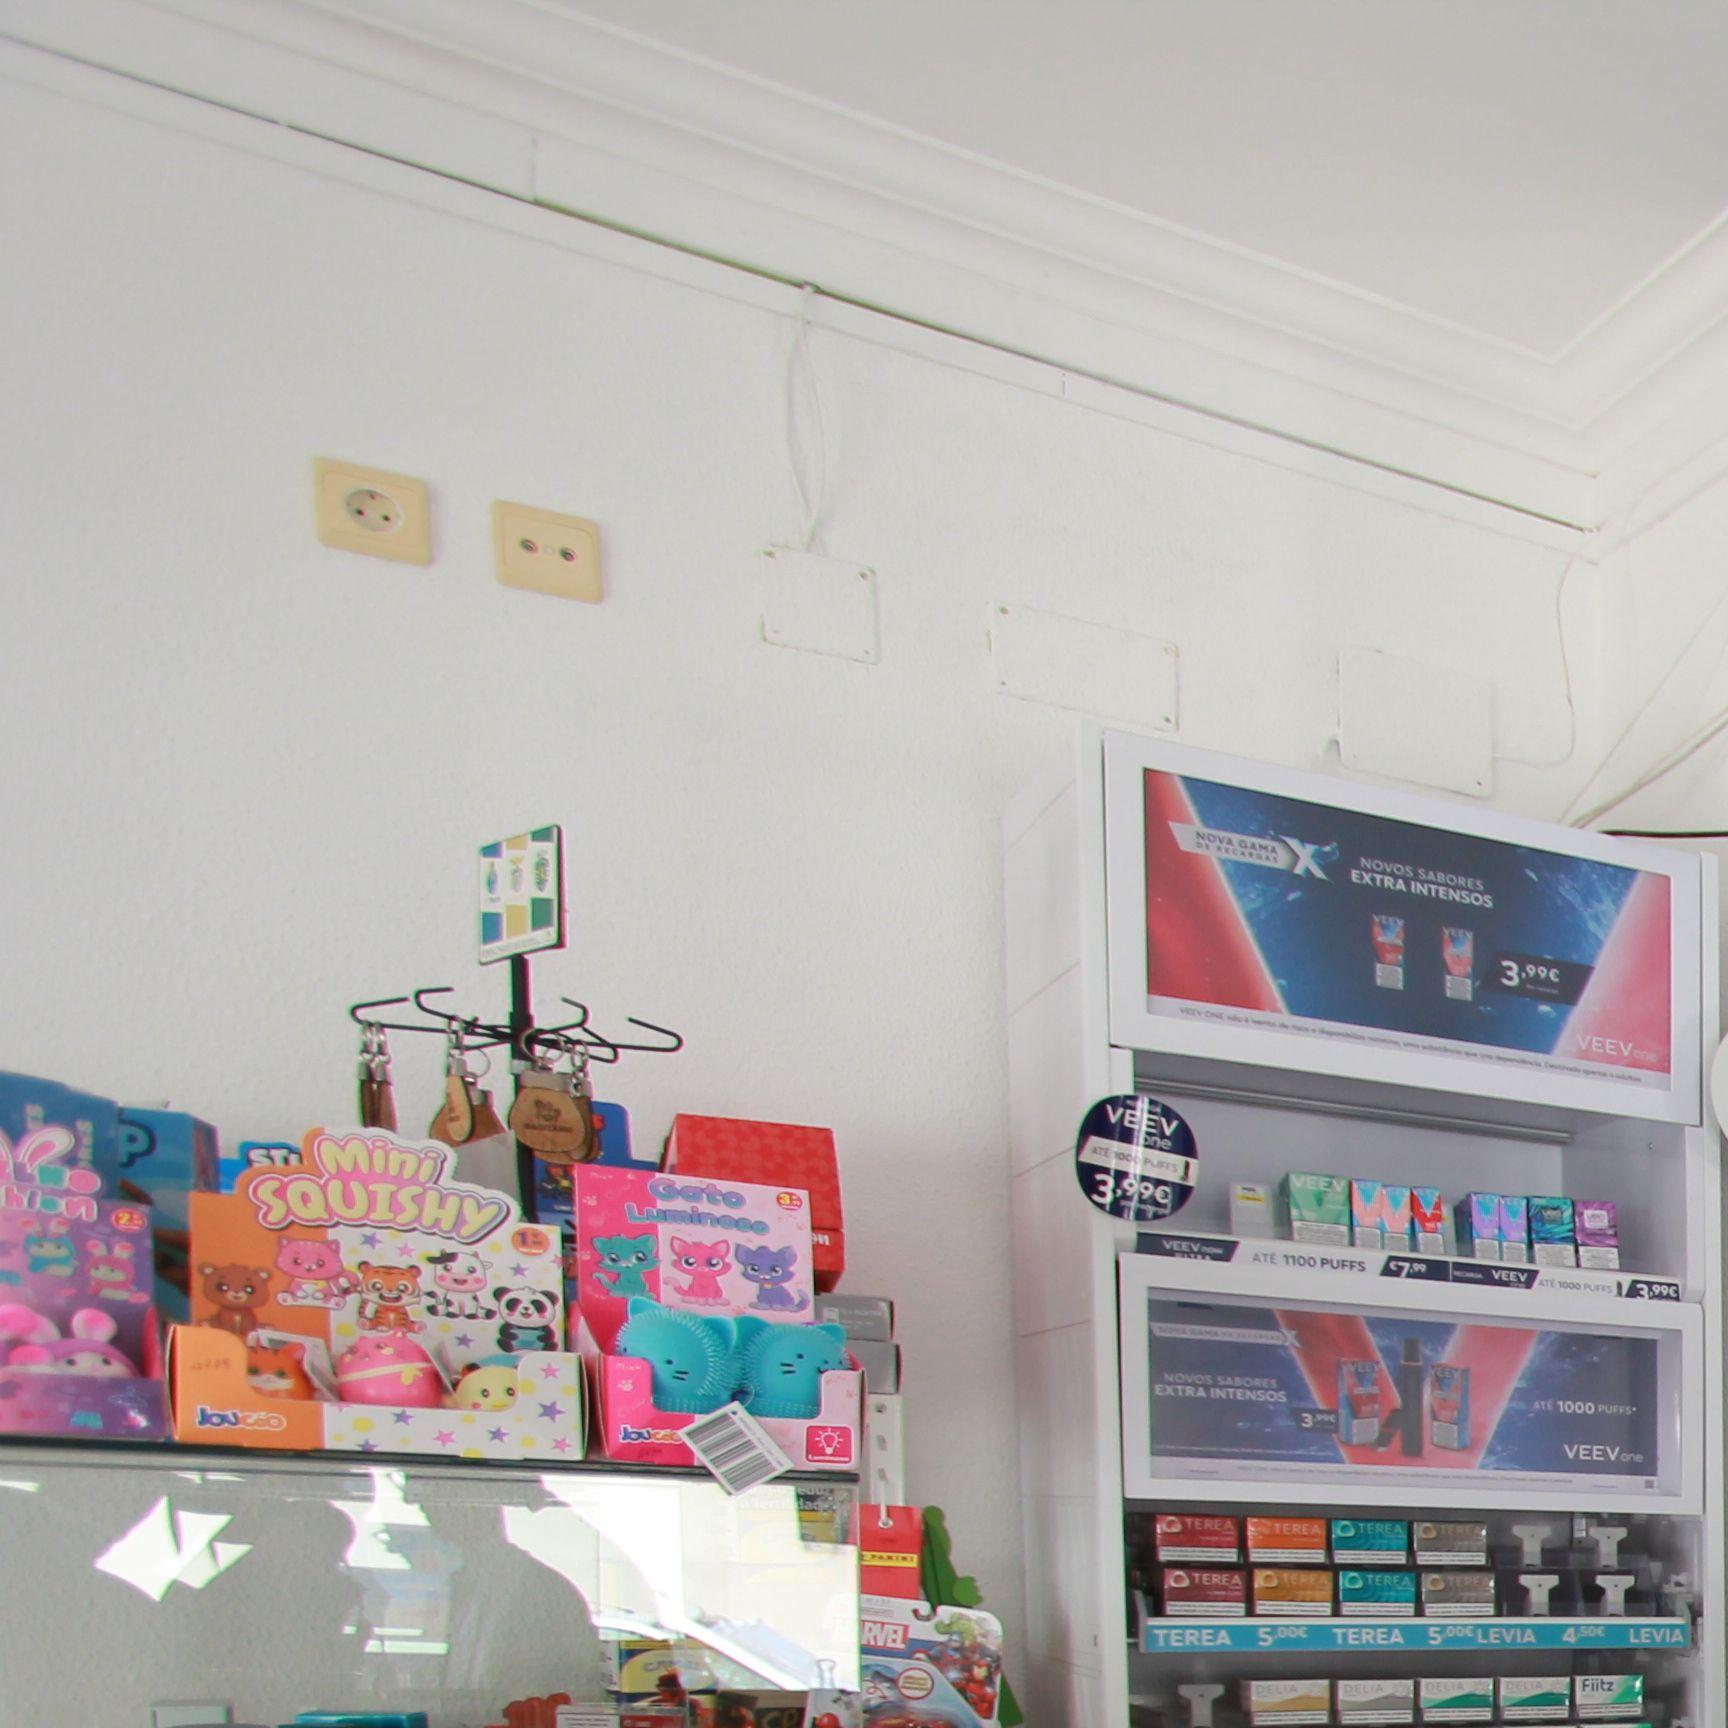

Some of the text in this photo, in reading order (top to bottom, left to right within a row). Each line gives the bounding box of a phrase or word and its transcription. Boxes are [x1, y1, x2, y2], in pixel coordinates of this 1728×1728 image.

[1195, 830, 1279, 857] NOVA GAMA
[1360, 856, 1484, 891] NOVOS SABORES
[1351, 870, 1493, 909] EXTRA INTENSOS
[1576, 1034, 1632, 1057] VEEV
[1106, 1103, 1179, 1136] VEEV
[320, 1138, 446, 1182] Mini
[1291, 1174, 1346, 1192] VEEV
[649, 1178, 747, 1210] Gato
[257, 1176, 506, 1239] SQUISHY
[626, 1203, 769, 1236] Luminoso
[1162, 1239, 1200, 1252] VEEV
[1252, 1251, 1366, 1272] ATÉ 1100 PUFFS
[1492, 1269, 1528, 1282] VEEV
[1163, 1372, 1277, 1389] NOVOS SABORES
[1154, 1384, 1287, 1403] EXTRA INTENSOS
[1533, 1399, 1553, 1412] ATÉ
[1557, 1400, 1595, 1415] 1000
[1563, 1443, 1644, 1463] VEEV one
[1185, 1517, 1237, 1531] TEREA
[1358, 1522, 1402, 1537] TEREA
[1154, 1628, 1231, 1647] TEREA
[1333, 1627, 1404, 1646] TEREA
[1476, 1627, 1536, 1645] LEVIA
[1629, 1628, 1684, 1645] LEVIA
[1255, 1683, 1297, 1698] DELIA
[1582, 1679, 1614, 1694] Fiitz
